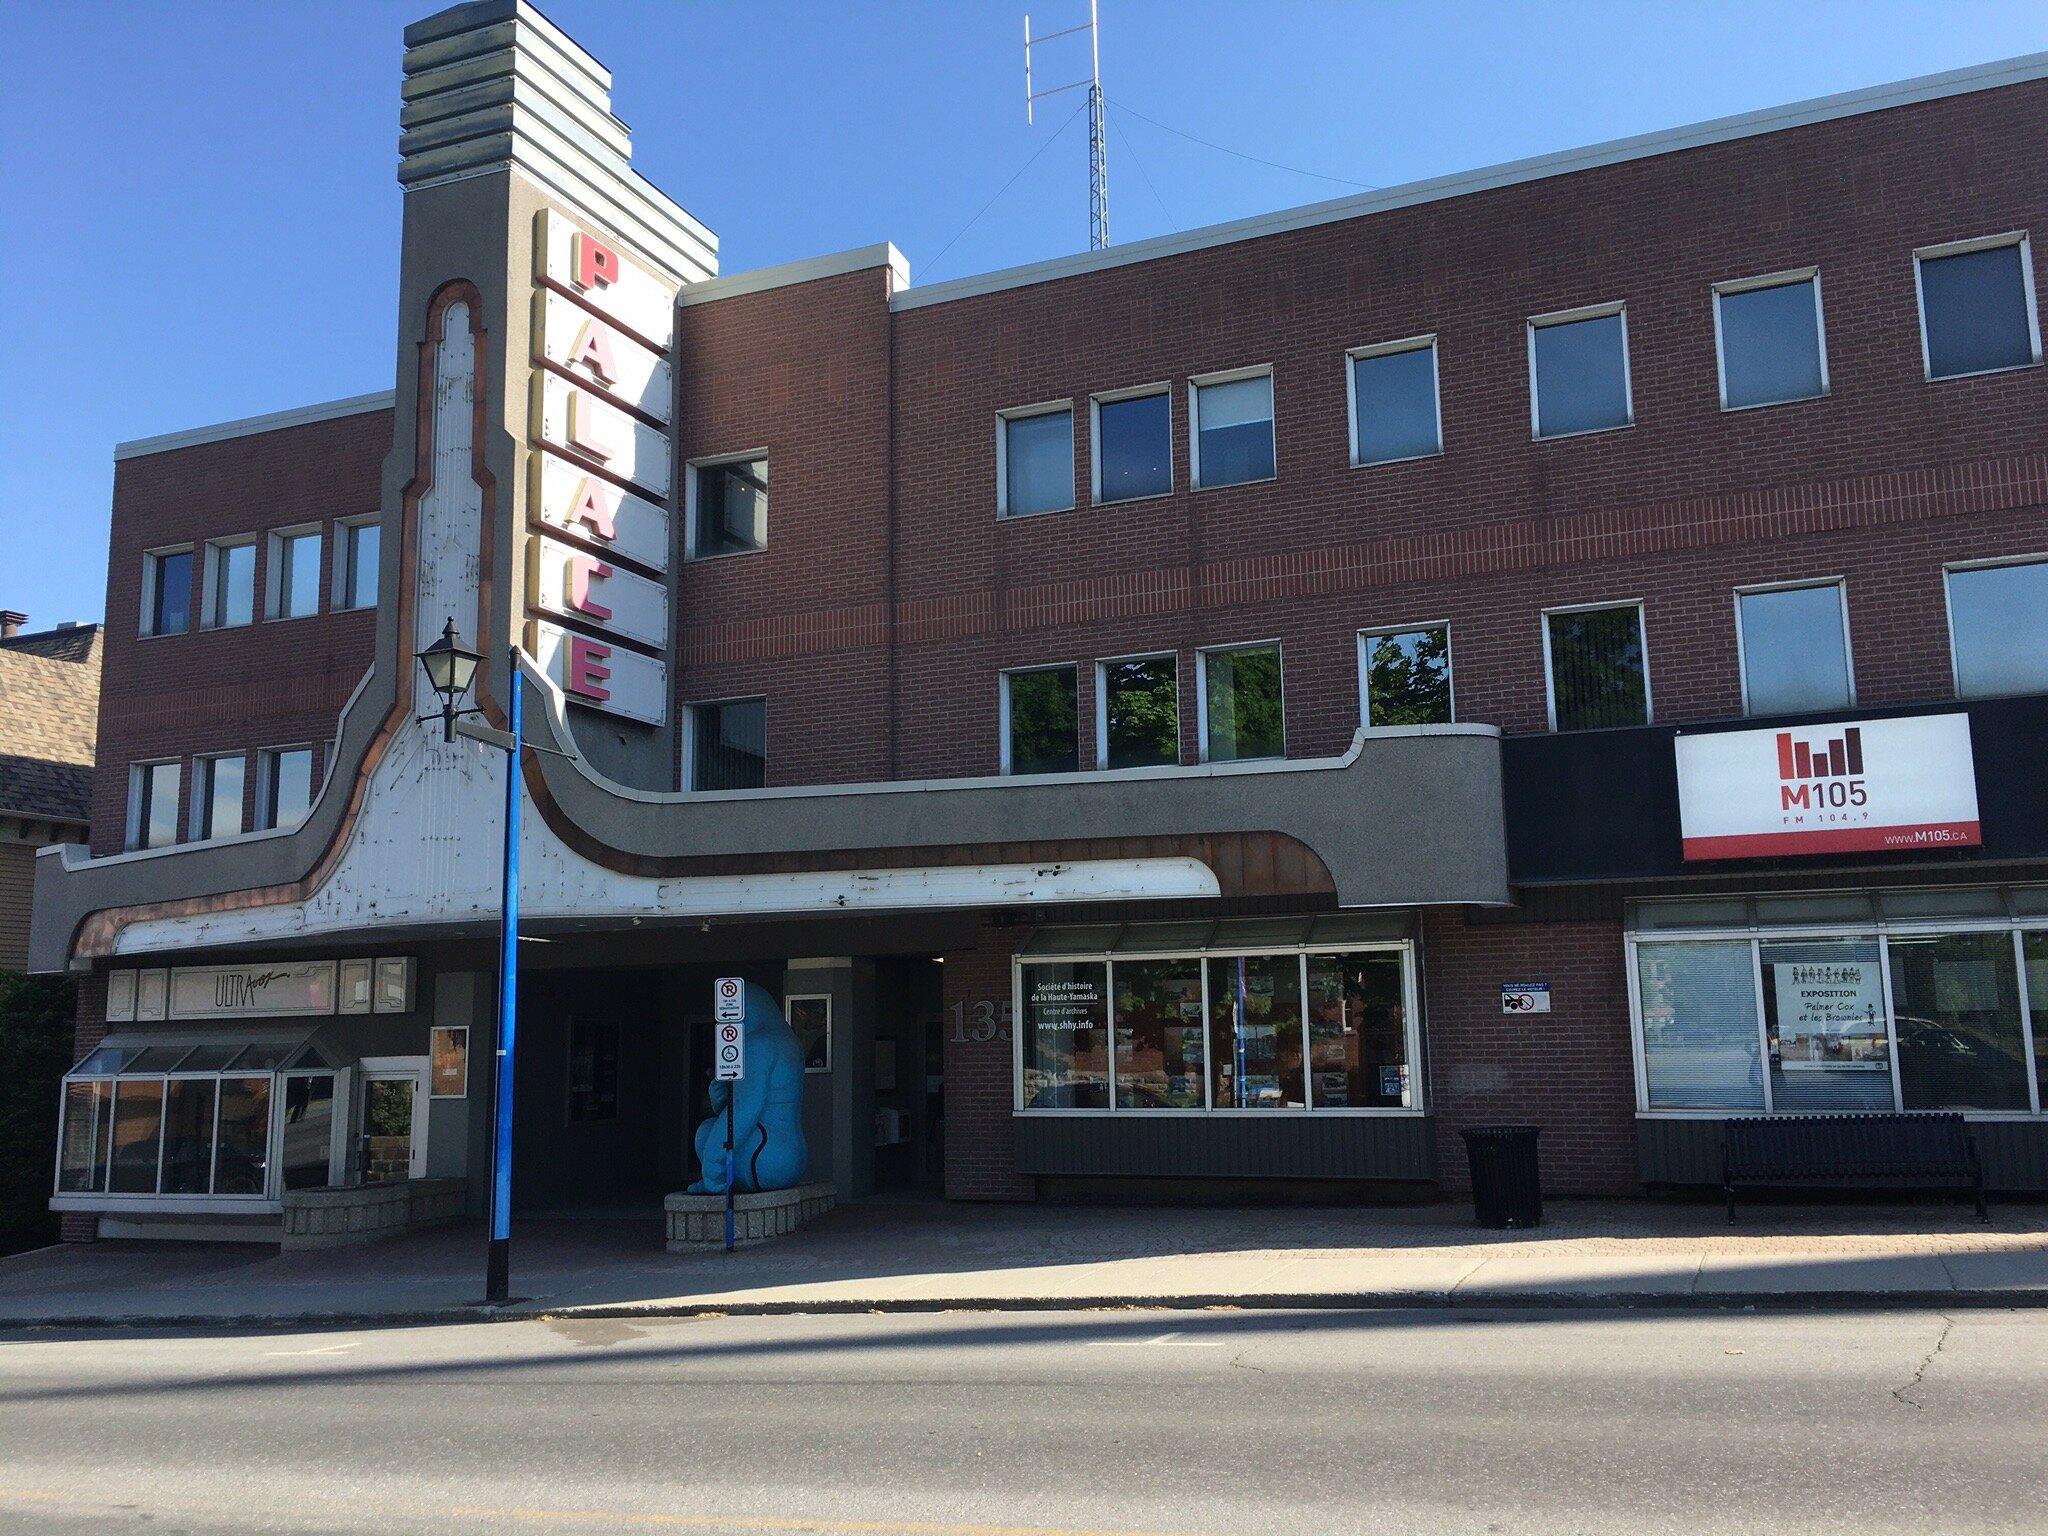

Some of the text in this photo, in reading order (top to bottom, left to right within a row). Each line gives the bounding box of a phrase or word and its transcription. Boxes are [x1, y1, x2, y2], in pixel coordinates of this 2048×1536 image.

[565, 231, 619, 702] PALACE
[1781, 780, 1867, 811] M105
[1783, 816, 1804, 825] FM
[1037, 981, 1093, 991] Société d'histoire
[1031, 992, 1098, 1002] de la Haute-Yamaska
[1800, 990, 1858, 998] EXPOSITION
[1804, 1002, 1855, 1011] Palmer Cox
[1811, 1013, 1822, 1021] les
[1826, 1012, 1863, 1021] Brownies
[1037, 1020, 1094, 1031] www.shhy.info
